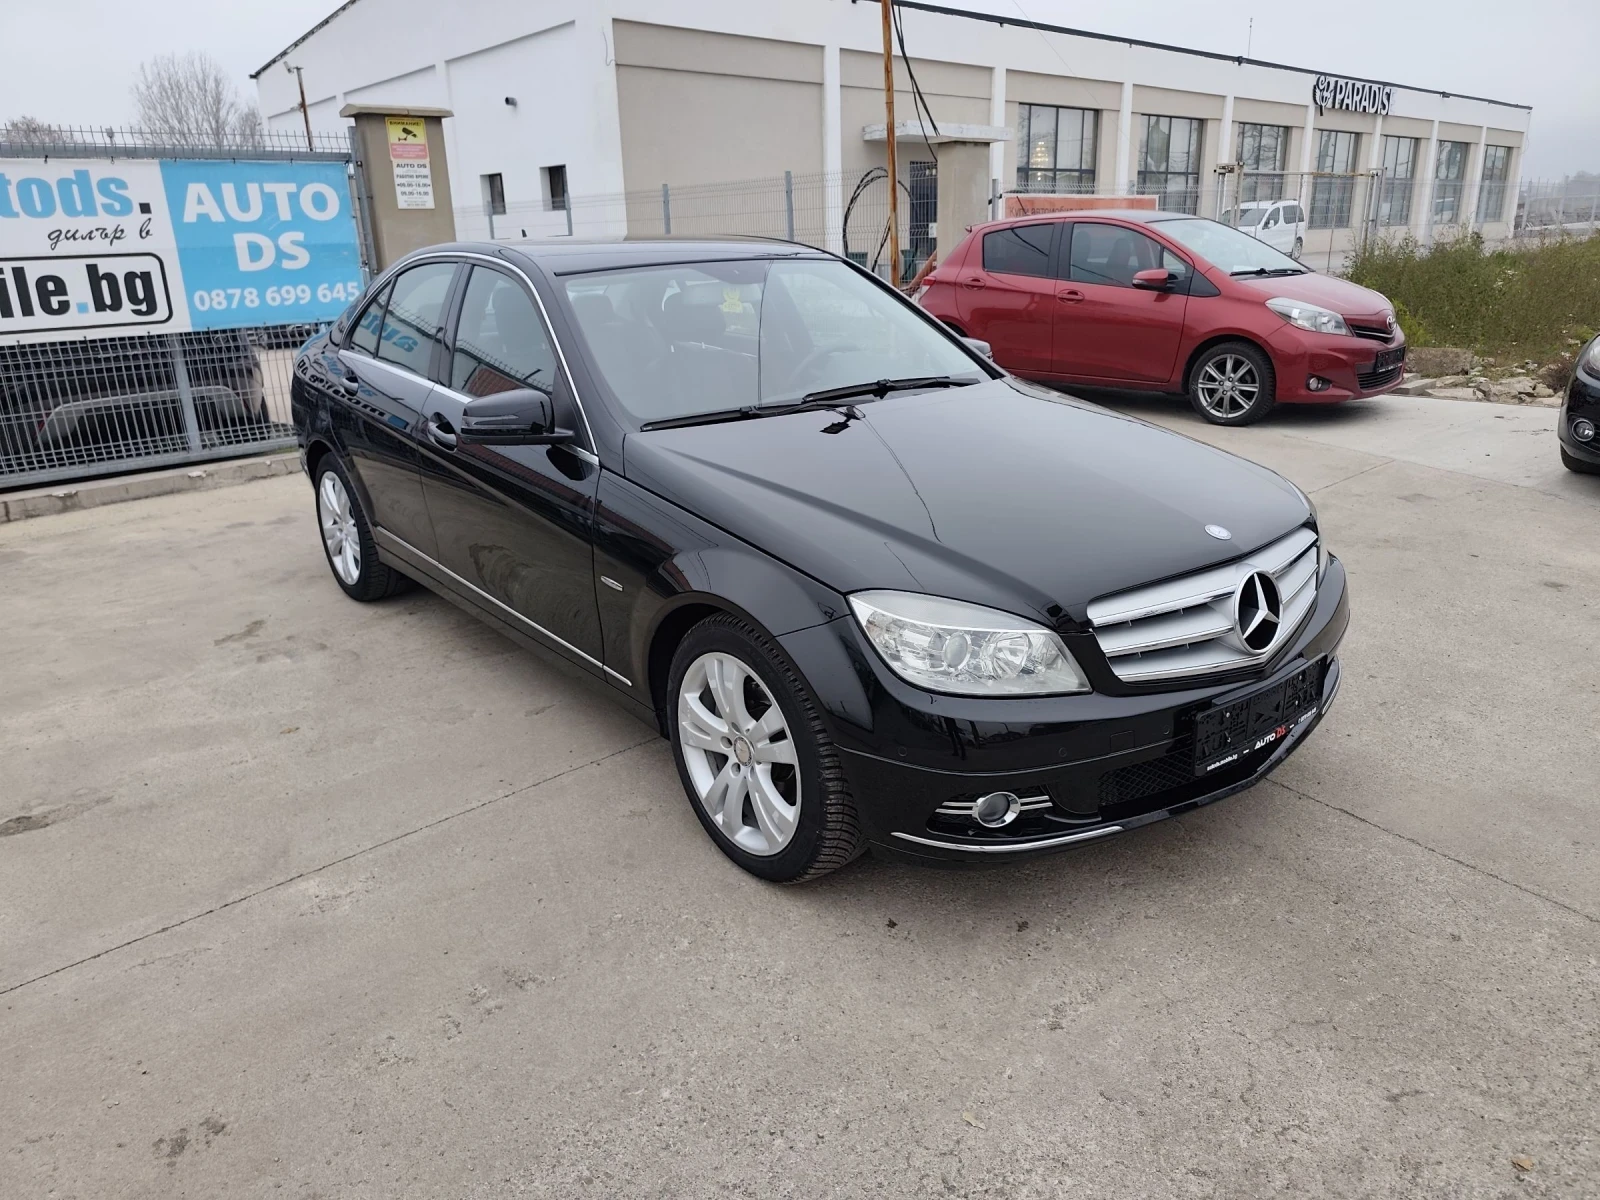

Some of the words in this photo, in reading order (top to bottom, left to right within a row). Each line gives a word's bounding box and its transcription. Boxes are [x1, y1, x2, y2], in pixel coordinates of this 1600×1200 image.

[183, 182, 340, 223] AUTO
[47, 223, 127, 251] дилър
[139, 217, 152, 240] в
[233, 231, 310, 272] DS
[193, 287, 260, 312] 0878
[265, 284, 312, 307] 699
[317, 281, 360, 304] 645
[1254, 732, 1276, 750] AUTO
